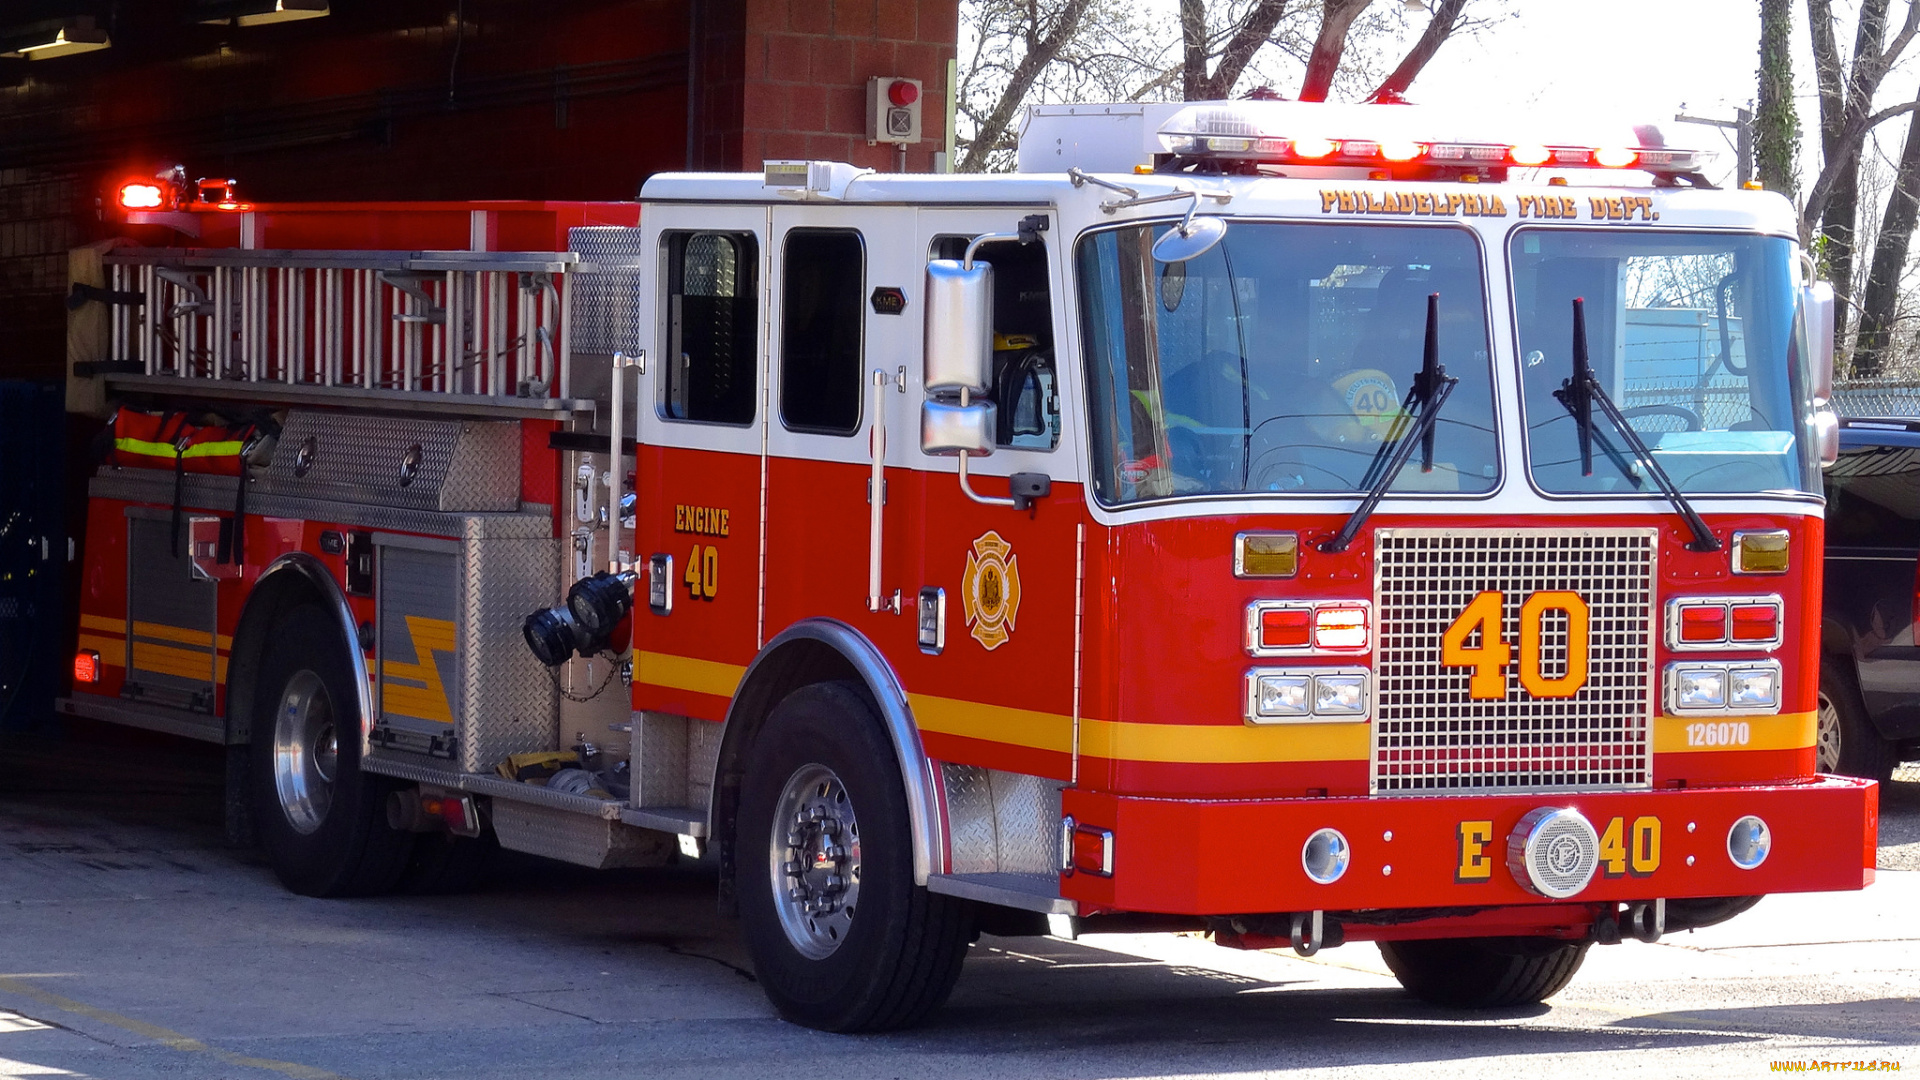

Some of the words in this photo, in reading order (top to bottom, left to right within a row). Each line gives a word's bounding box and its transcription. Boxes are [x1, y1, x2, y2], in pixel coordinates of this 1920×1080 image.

[1319, 189, 1507, 217] PHILADELPHIA
[1517, 194, 1577, 219] FIRE
[1588, 196, 1660, 221] DEPT.
[876, 296, 897, 306] KME
[1357, 390, 1388, 413] 40
[675, 504, 729, 537] ENGINE
[684, 544, 718, 601] 40
[1441, 590, 1590, 699] 40
[1686, 722, 1750, 746] 126070
[1455, 820, 1493, 883] E
[1600, 816, 1661, 878] 40
